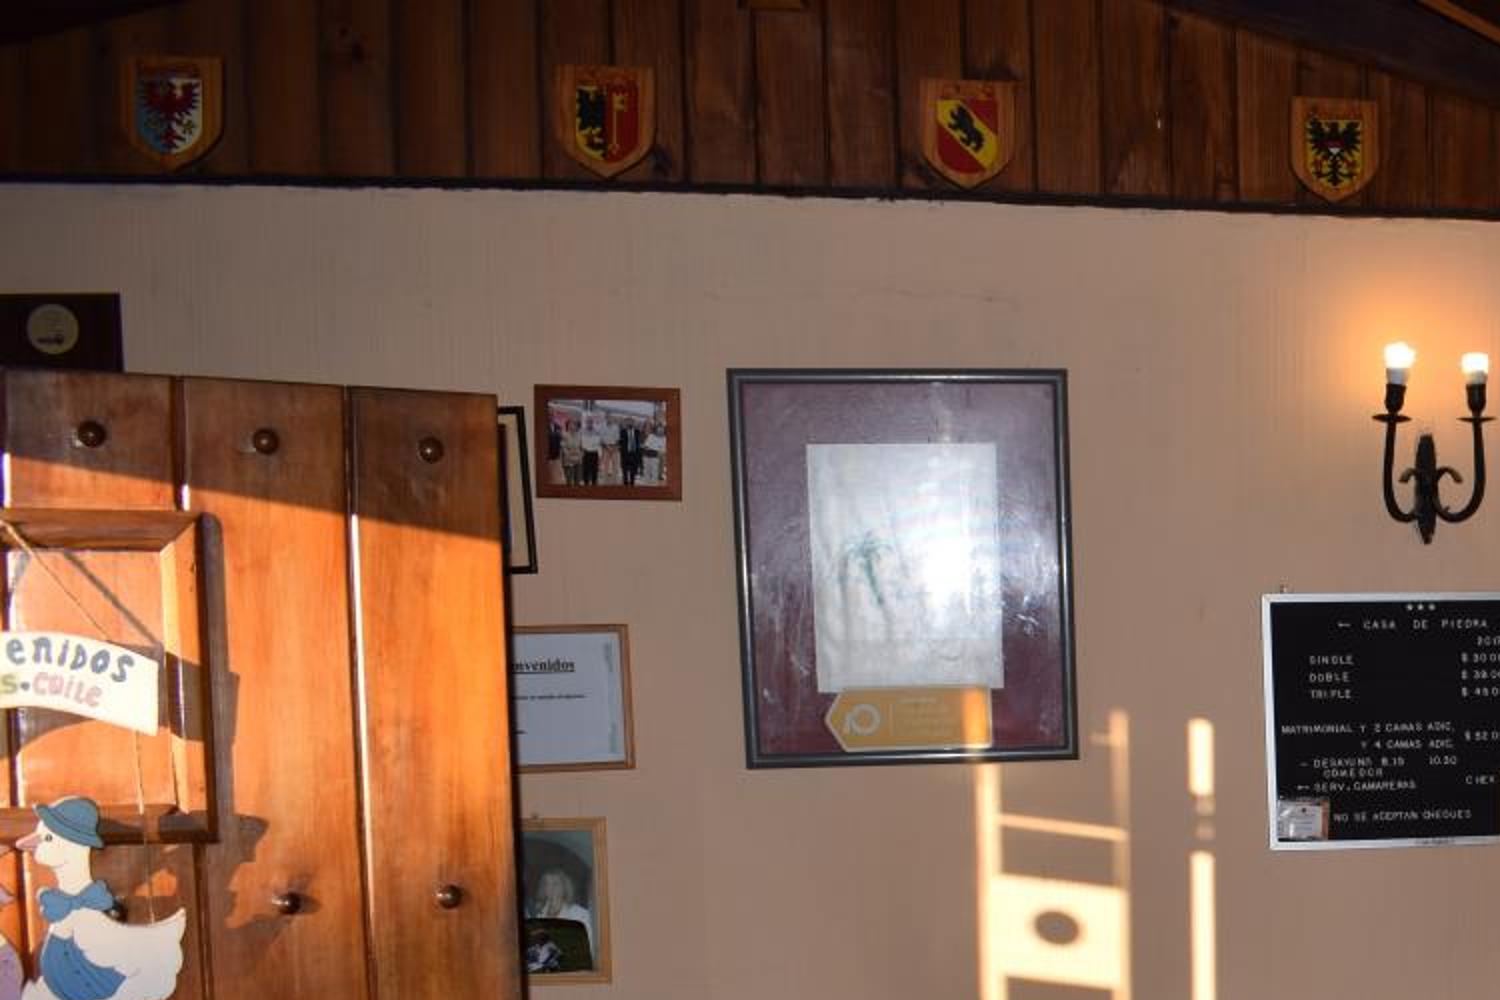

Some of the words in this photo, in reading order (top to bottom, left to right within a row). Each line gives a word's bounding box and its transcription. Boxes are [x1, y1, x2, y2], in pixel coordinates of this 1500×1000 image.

[1363, 619, 1397, 630] CASA
[1413, 618, 1429, 629] DE
[1441, 618, 1488, 629] PIEDRA
[1309, 672, 1351, 682] DOBLE
[1311, 689, 1352, 700] TRIPLE
[1281, 723, 1353, 734] MATRIMONIAL
[1386, 722, 1422, 732] CAMAS
[1386, 739, 1422, 749] CAMAS
[1323, 767, 1384, 778] COMEDOR
[1333, 812, 1349, 823] NO
[1353, 811, 1368, 822] SE
[1372, 810, 1419, 821] ACEPTAN
